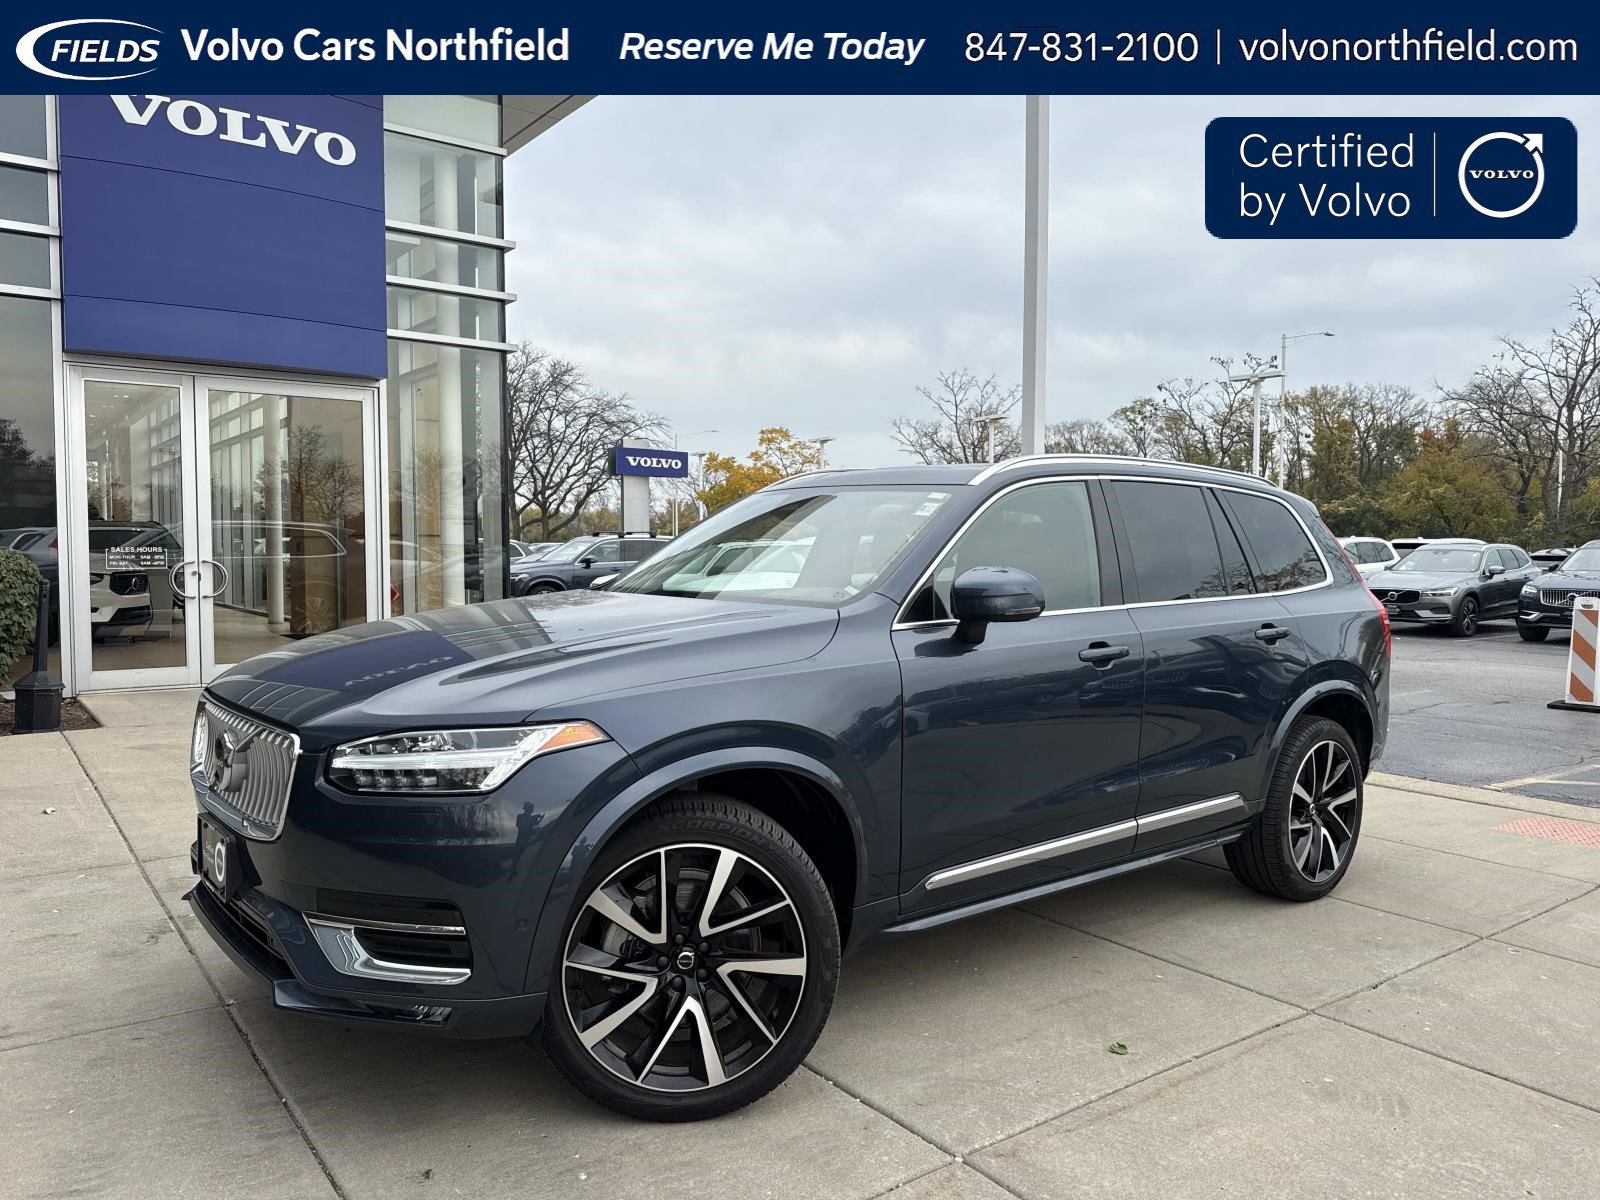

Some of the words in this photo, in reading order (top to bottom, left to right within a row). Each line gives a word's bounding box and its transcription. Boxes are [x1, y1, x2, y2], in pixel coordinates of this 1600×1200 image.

[110, 95, 357, 166] VOLVO
[625, 456, 682, 469] VOLVO
[658, 820, 765, 846] SCORPION
